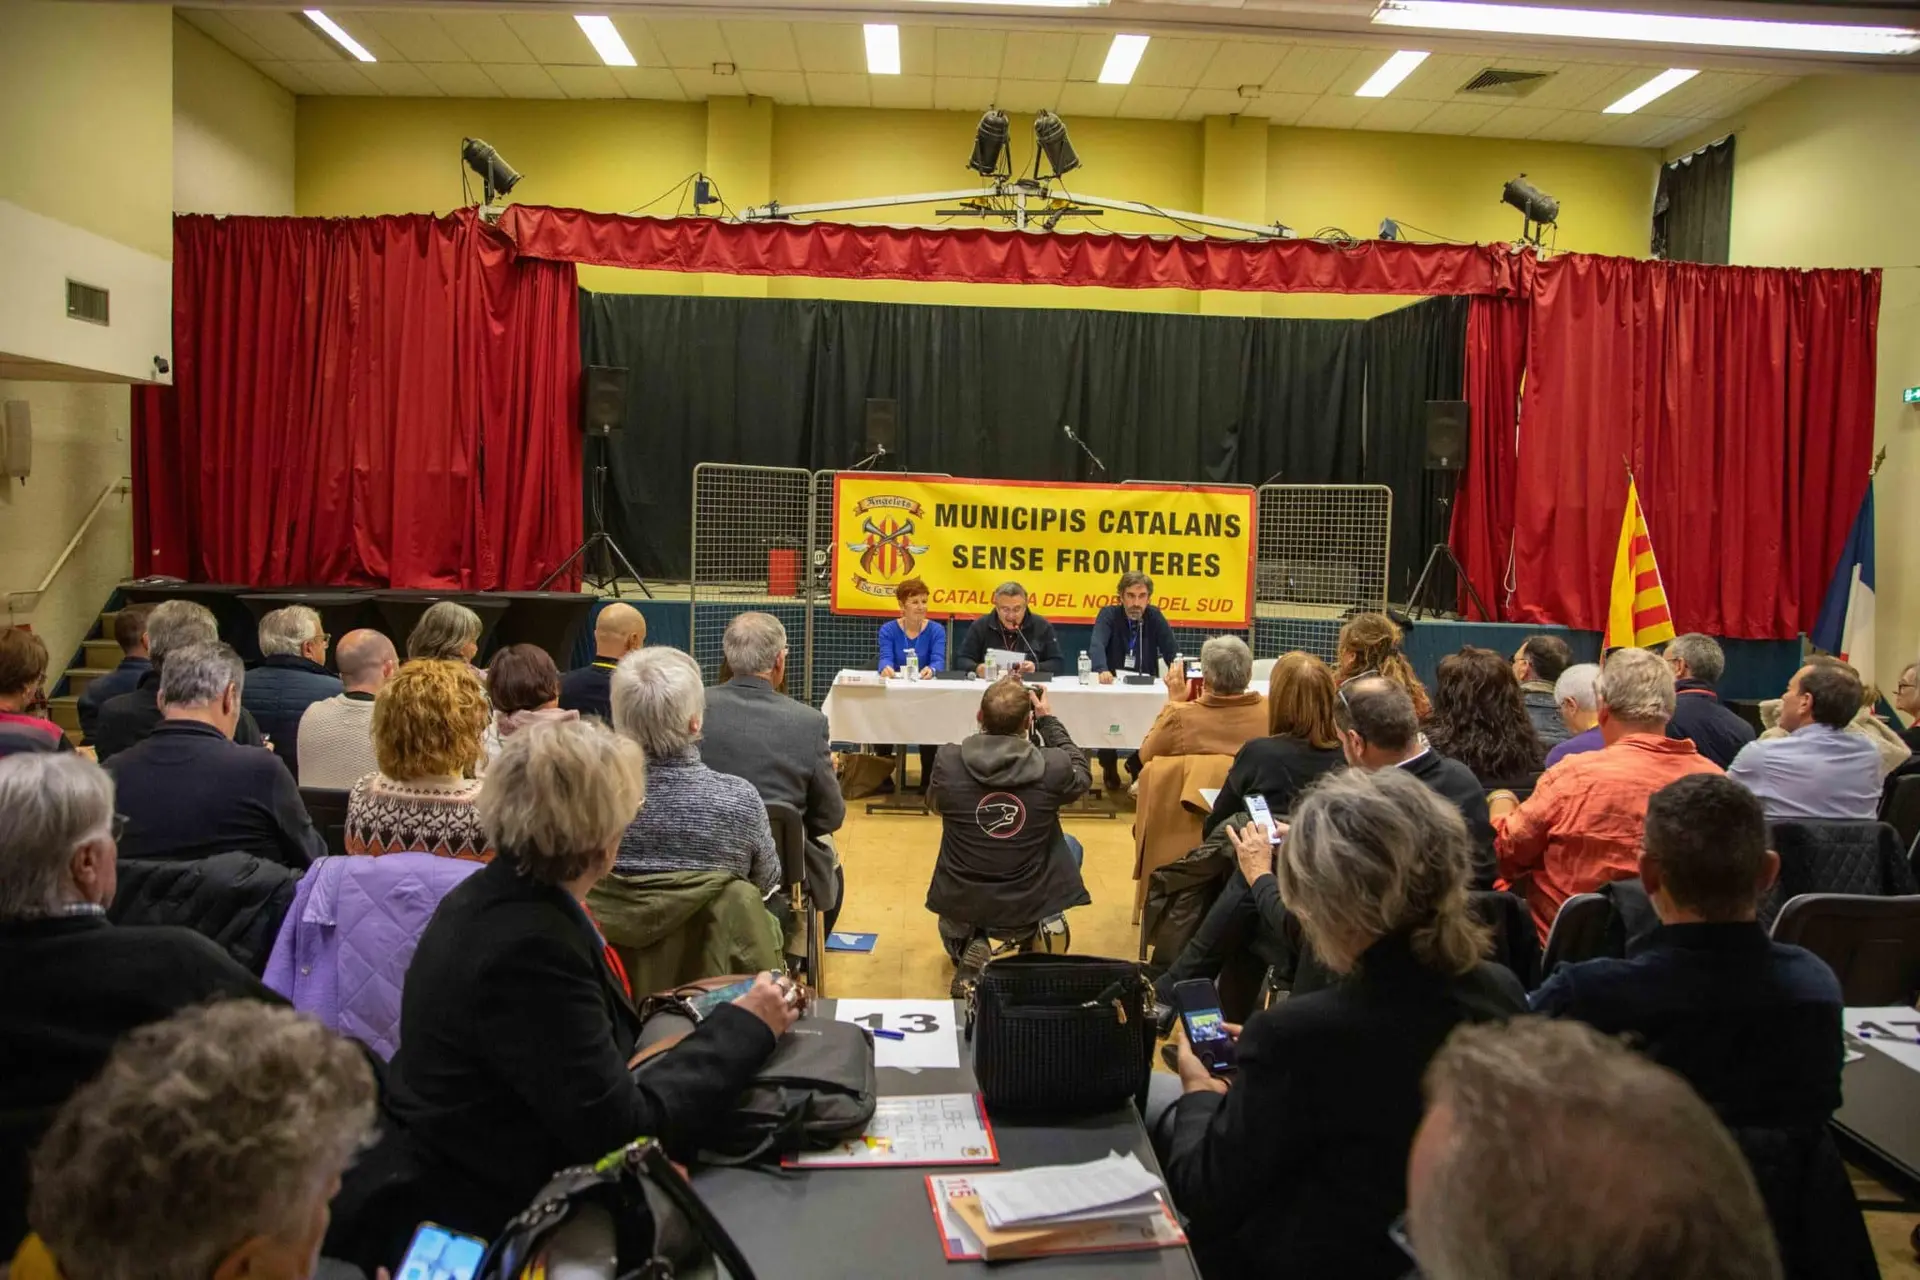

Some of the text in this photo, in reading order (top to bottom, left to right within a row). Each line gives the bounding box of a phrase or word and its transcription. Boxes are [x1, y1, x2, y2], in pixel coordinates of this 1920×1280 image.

[868, 497, 911, 508] Angelets
[935, 503, 1241, 538] MUNICIPIS CATALANS
[952, 544, 1220, 577] SENSE FRONTERES
[932, 589, 1037, 607] CATALA
[1043, 593, 1077, 608] DEL
[1157, 597, 1191, 611] DEL
[1196, 598, 1233, 613] SUD
[853, 1012, 940, 1034] 13
